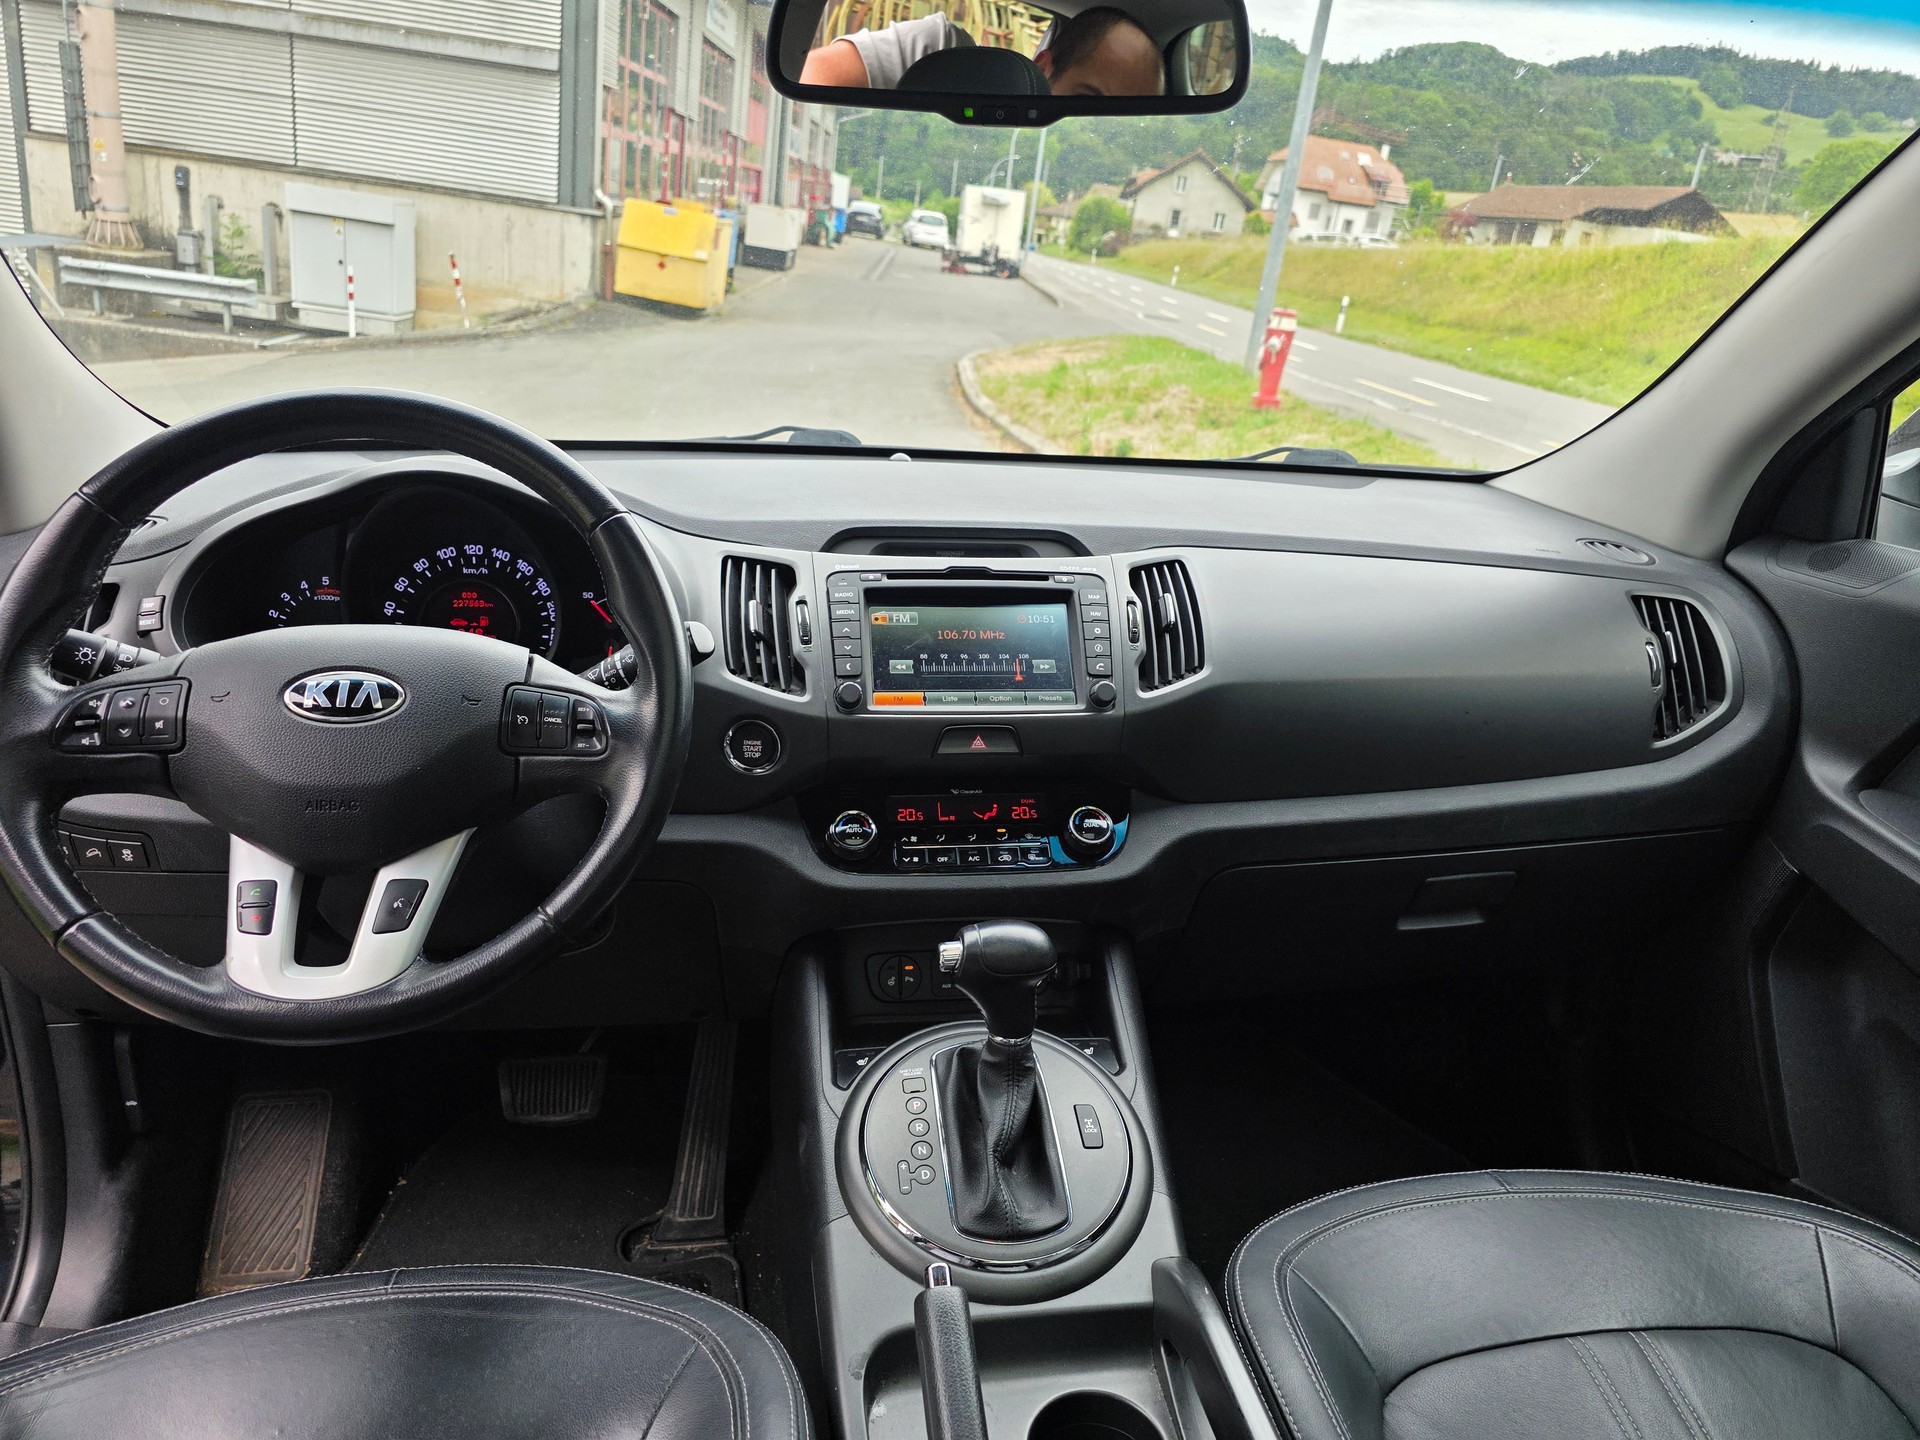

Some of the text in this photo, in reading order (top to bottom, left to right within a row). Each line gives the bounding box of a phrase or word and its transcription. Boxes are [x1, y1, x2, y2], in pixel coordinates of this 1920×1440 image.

[436, 547, 456, 560] 100
[464, 544, 483, 555] 120
[491, 547, 511, 562] 140
[413, 558, 429, 573] 80
[517, 559, 534, 576] 160
[463, 567, 488, 575] km/h
[300, 580, 308, 589] 4
[322, 576, 330, 586] 5
[394, 577, 409, 592] 60
[536, 577, 551, 596] 180
[280, 592, 291, 602] 3
[268, 609, 279, 618] 2
[384, 601, 395, 616] 40
[893, 614, 910, 623] FM
[1028, 615, 1055, 623] 10:51
[937, 630, 1006, 640] 106.70 MHz
[303, 680, 383, 708] KIA
[989, 695, 1012, 703] Option
[544, 716, 563, 724] CANCEL
[305, 801, 360, 813] AIRBAG
[897, 809, 924, 821] 20.5
[1011, 806, 1038, 819] 20.5
[913, 1101, 921, 1110] P
[915, 1123, 924, 1132] R
[918, 1145, 927, 1155] N
[921, 1169, 930, 1179] D
